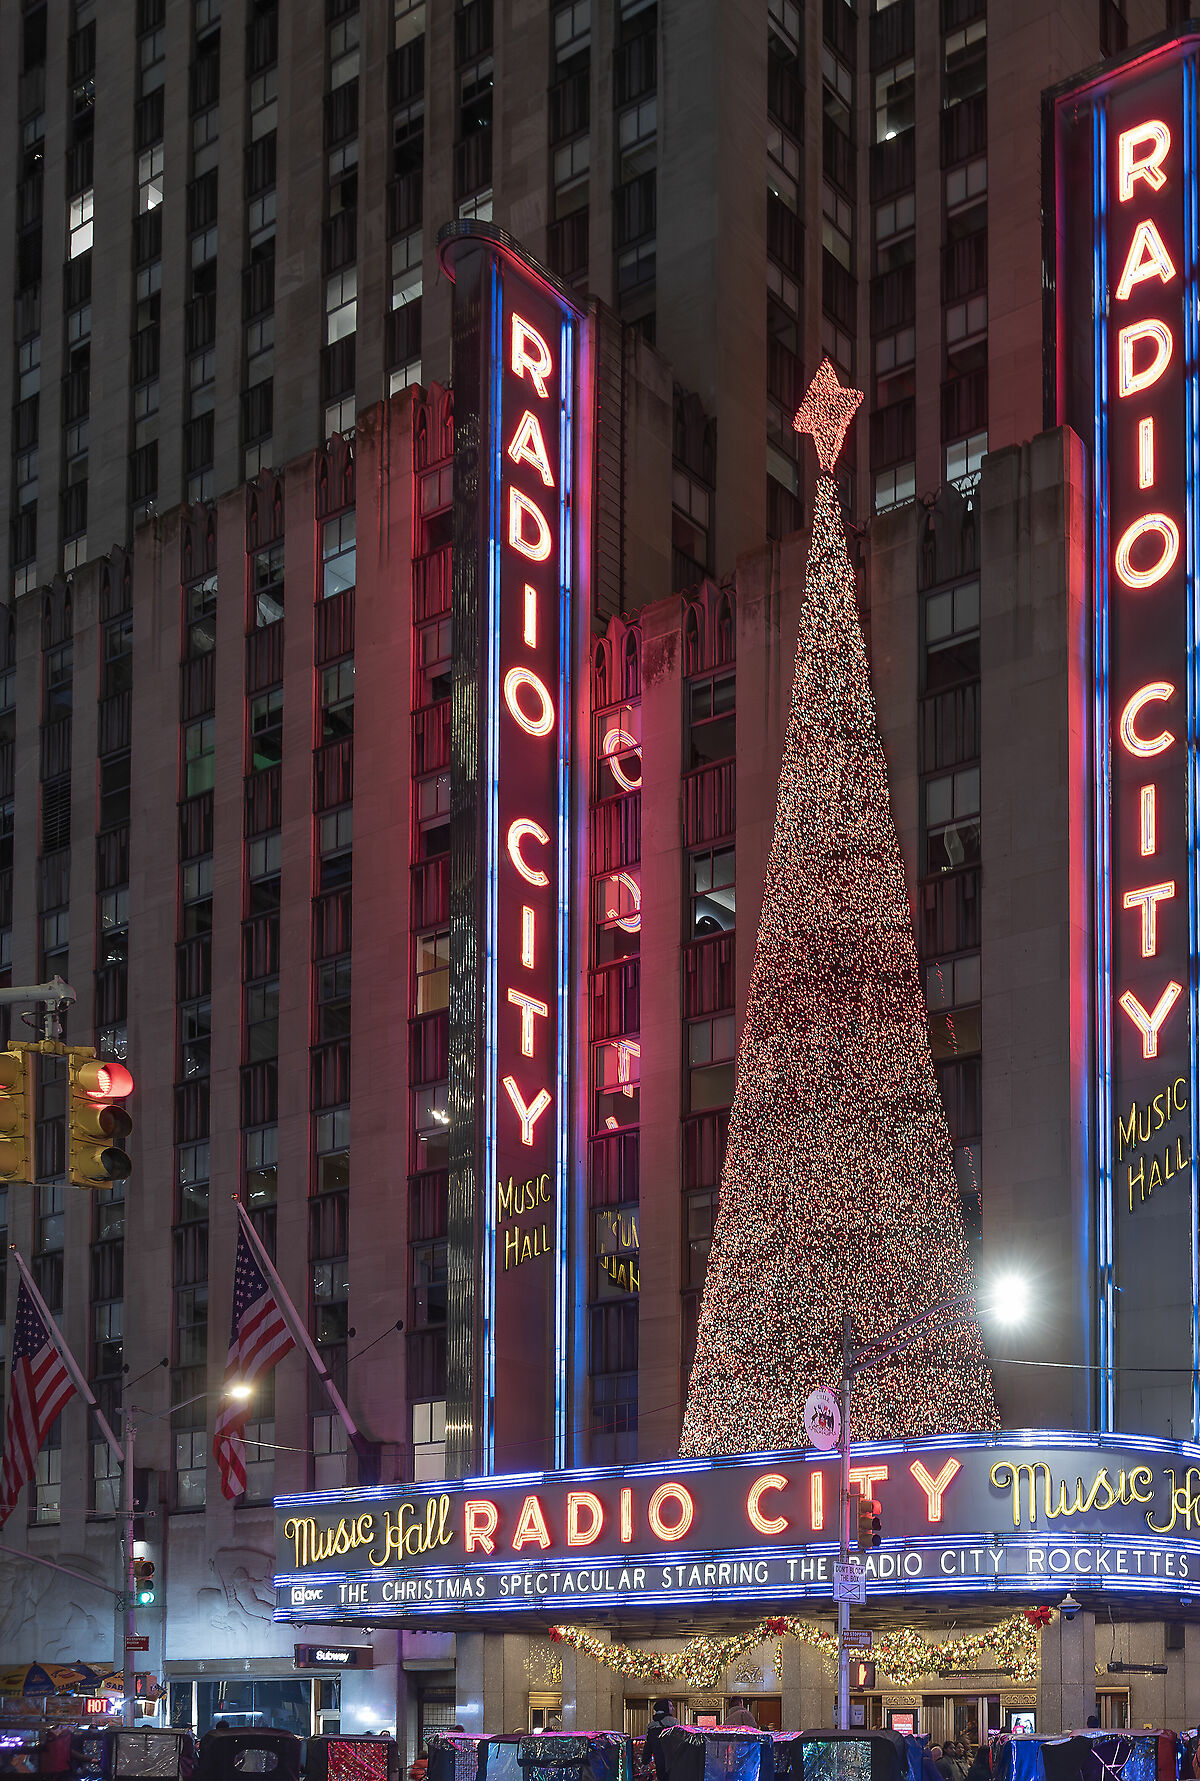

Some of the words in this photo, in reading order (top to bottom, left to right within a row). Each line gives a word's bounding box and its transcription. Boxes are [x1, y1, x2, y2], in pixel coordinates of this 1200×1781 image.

[1114, 118, 1180, 590] RADIO
[503, 310, 556, 738] RADIO
[1118, 680, 1183, 1060] CITY
[502, 816, 553, 1148] CITY
[1118, 1077, 1187, 1162] MUSIC
[497, 1174, 551, 1223] MUSIC
[1127, 1136, 1187, 1212] HALL
[504, 1224, 551, 1271] HALL
[284, 1513, 375, 1568] Music
[368, 1493, 454, 1566] Hall
[463, 1481, 694, 1555] RADIO
[746, 1456, 962, 1535] CITY
[989, 1461, 1154, 1526] Music
[339, 1583, 369, 1604] THE
[382, 1576, 486, 1602] CHRISTMAS
[499, 1567, 647, 1597] SPECTACULAR
[660, 1560, 769, 1590] STARRING
[786, 1557, 829, 1582] THE
[940, 1549, 1004, 1575] CITY
[1028, 1548, 1189, 1578] ROCKETTES
[840, 1574, 849, 1582] THE
[850, 1575, 860, 1583] BOX
[105, 1681, 125, 1690] SAB
[315, 1649, 350, 1663] Subway
[87, 1698, 109, 1714] HOT
